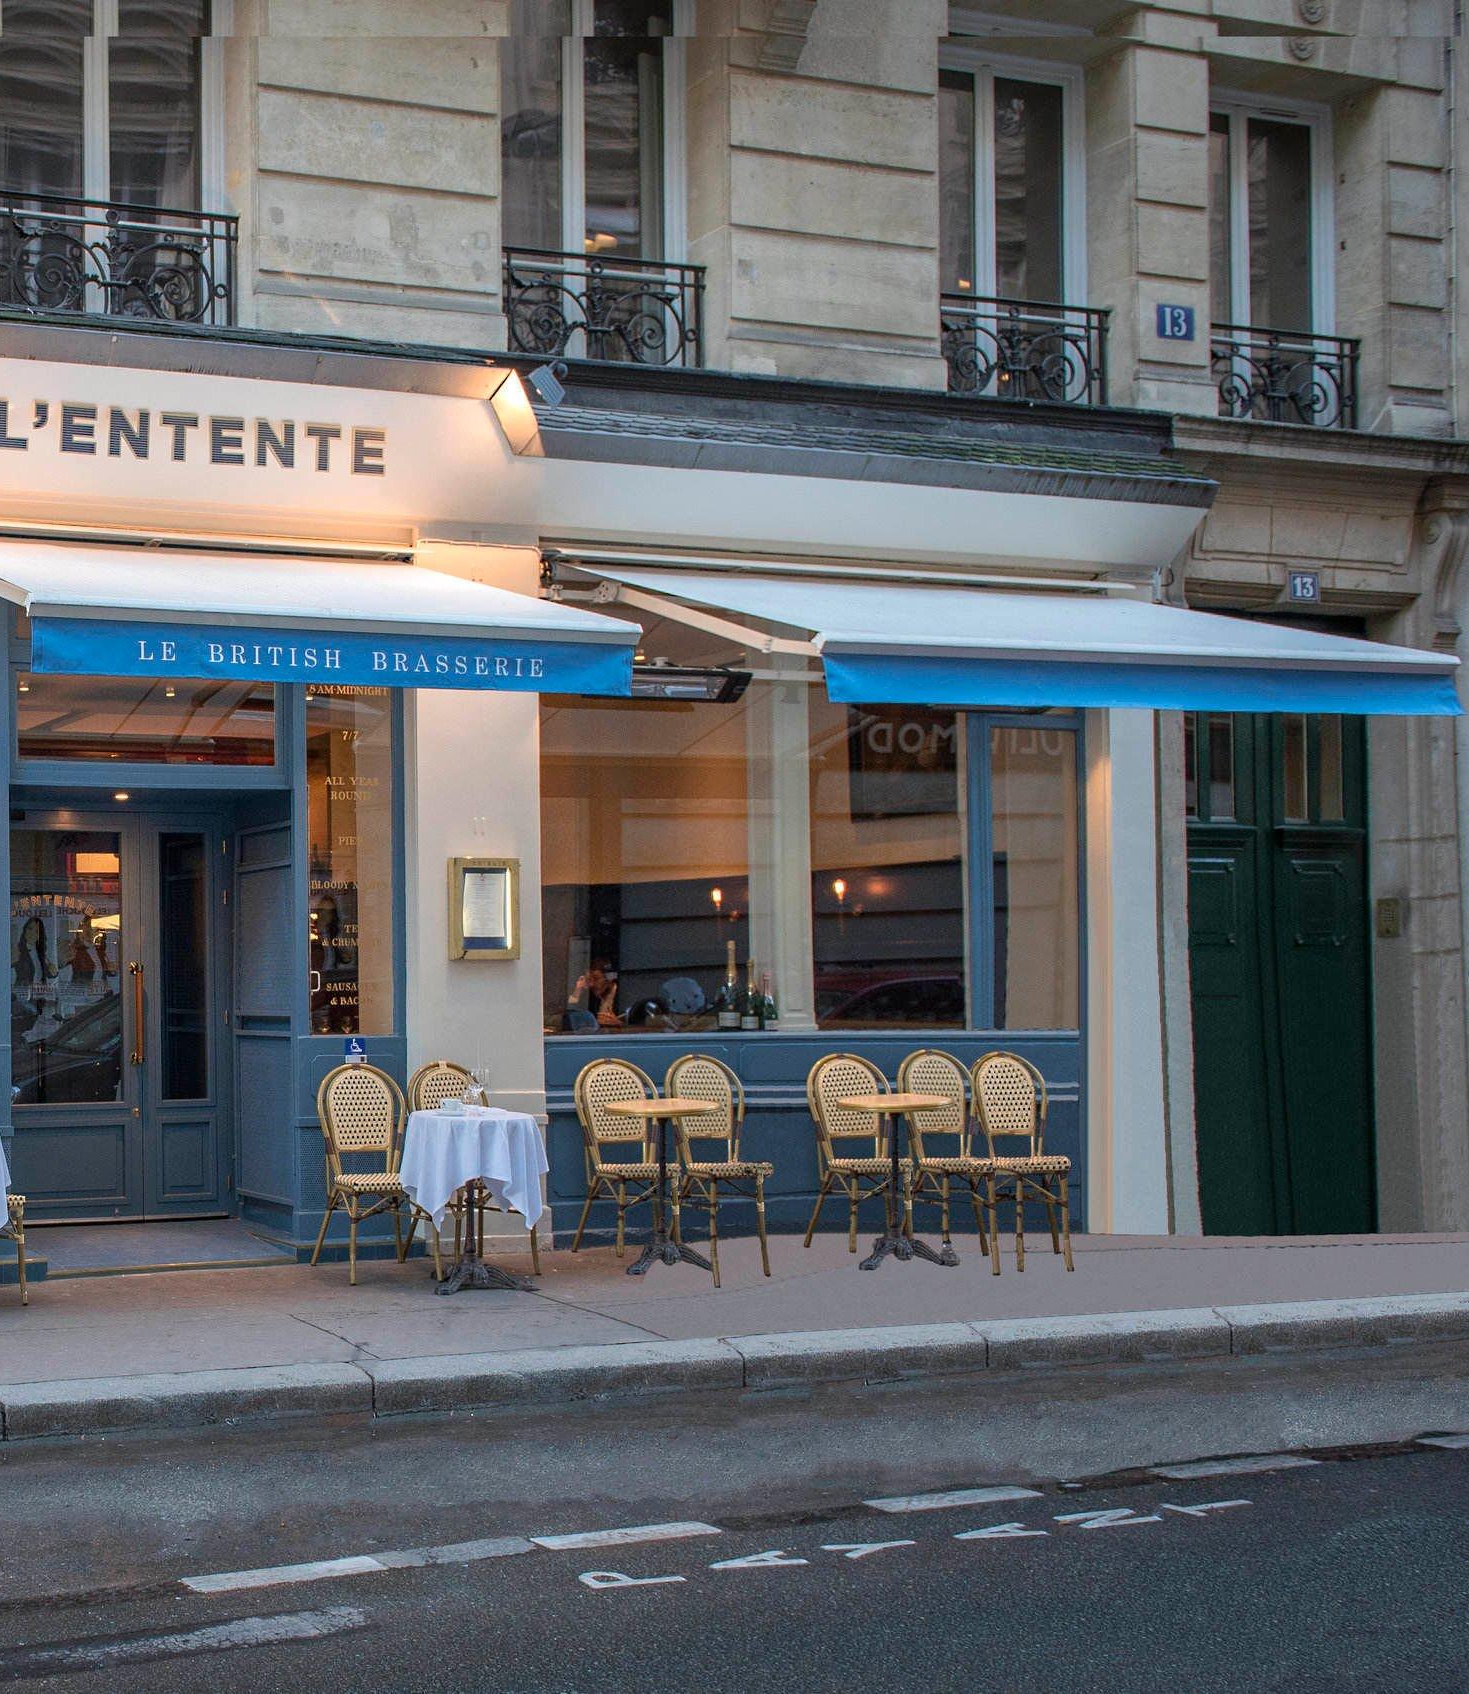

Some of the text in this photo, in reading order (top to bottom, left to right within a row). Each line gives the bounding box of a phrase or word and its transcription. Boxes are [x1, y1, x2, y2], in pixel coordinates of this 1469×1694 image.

[1162, 307, 1188, 337] 13
[1294, 577, 1314, 598] 13
[138, 641, 544, 678] LE BRITISH BRASSERIE
[342, 730, 360, 741] 7/7
[324, 776, 345, 786] ALL
[331, 790, 372, 801] ROUND
[311, 880, 349, 889] BLOODY
[321, 938, 330, 947] &
[330, 996, 338, 1006] &
[577, 1499, 1254, 1590] PAYANT
